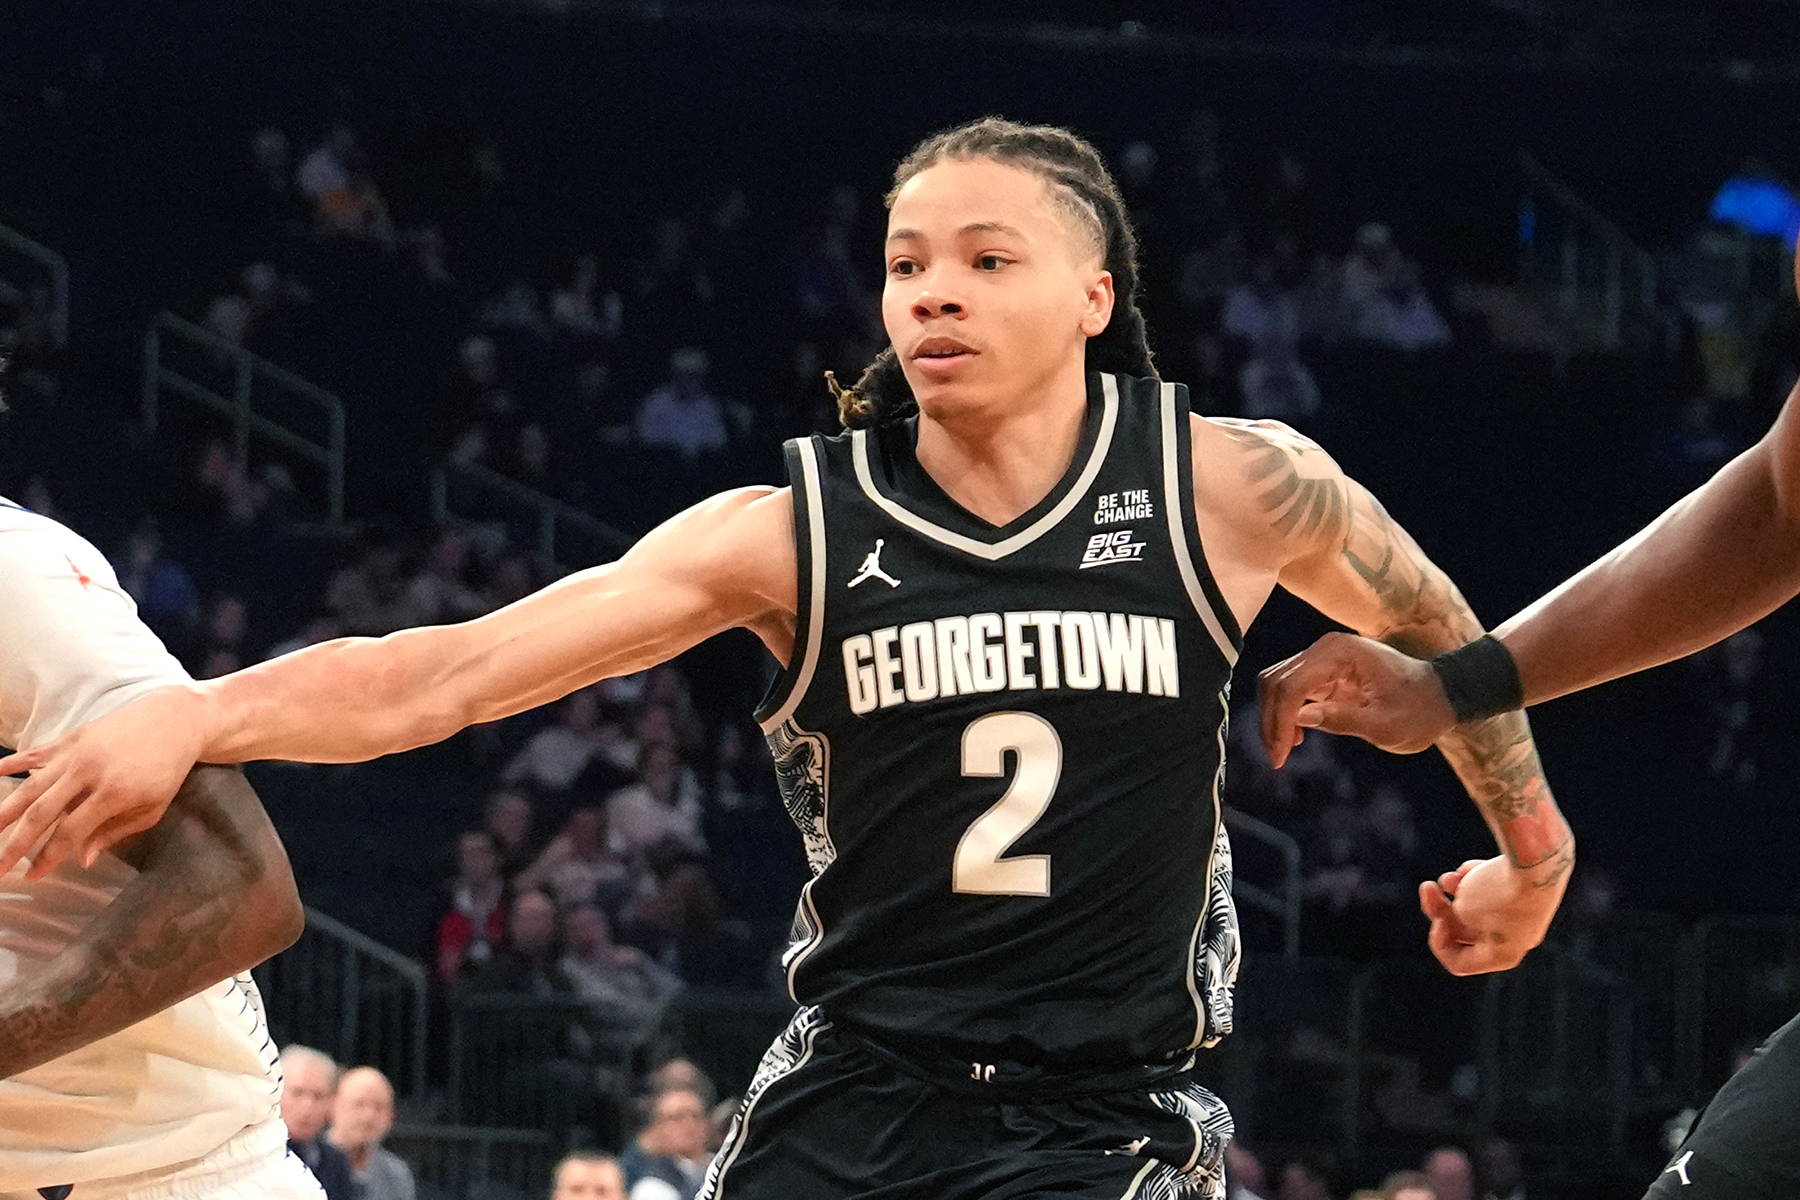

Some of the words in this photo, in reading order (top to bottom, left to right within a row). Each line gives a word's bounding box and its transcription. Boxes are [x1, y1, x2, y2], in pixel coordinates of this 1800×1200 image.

[1098, 493, 1119, 510] BE
[1122, 489, 1150, 506] THE
[1094, 503, 1154, 525] CHANGE
[1086, 529, 1134, 550] BIG
[1081, 541, 1147, 563] EAST
[842, 610, 1180, 716] GEORGETOWN
[952, 711, 1063, 898] 2
